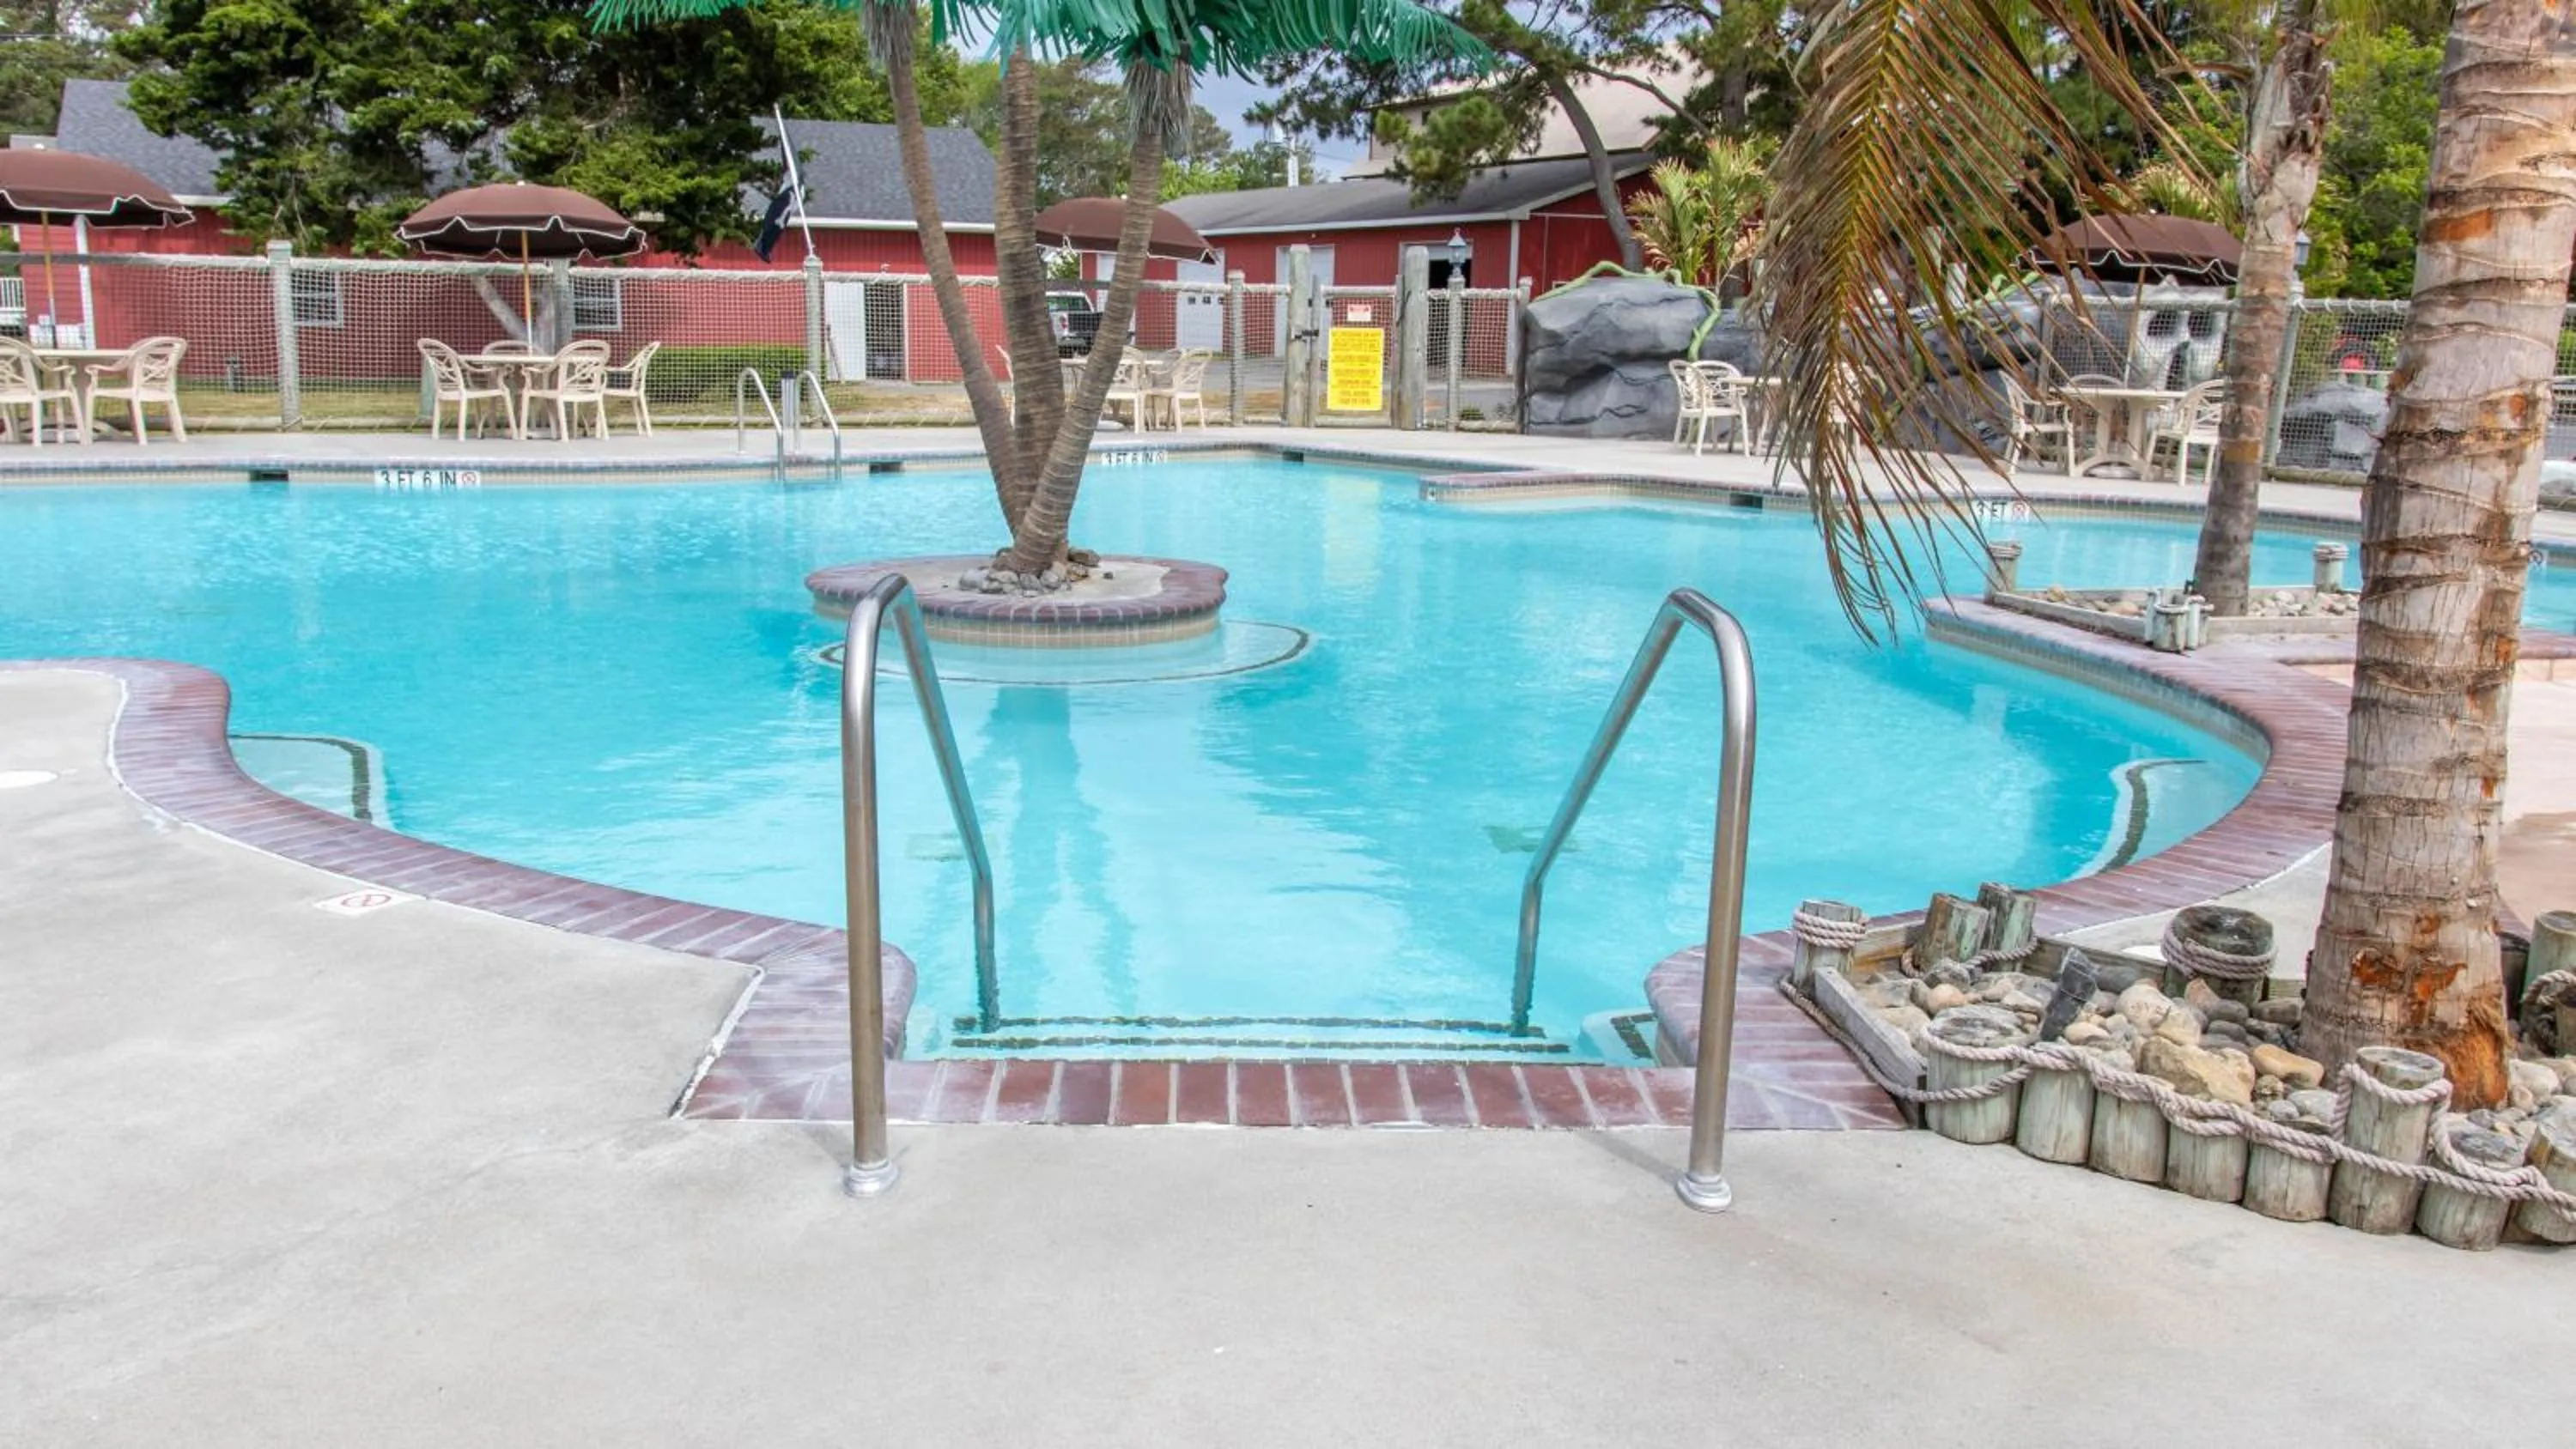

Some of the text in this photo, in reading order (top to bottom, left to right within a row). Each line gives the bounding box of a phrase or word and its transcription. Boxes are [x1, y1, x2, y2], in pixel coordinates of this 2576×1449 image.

[380, 470, 456, 485] 3 FT 6 IN
